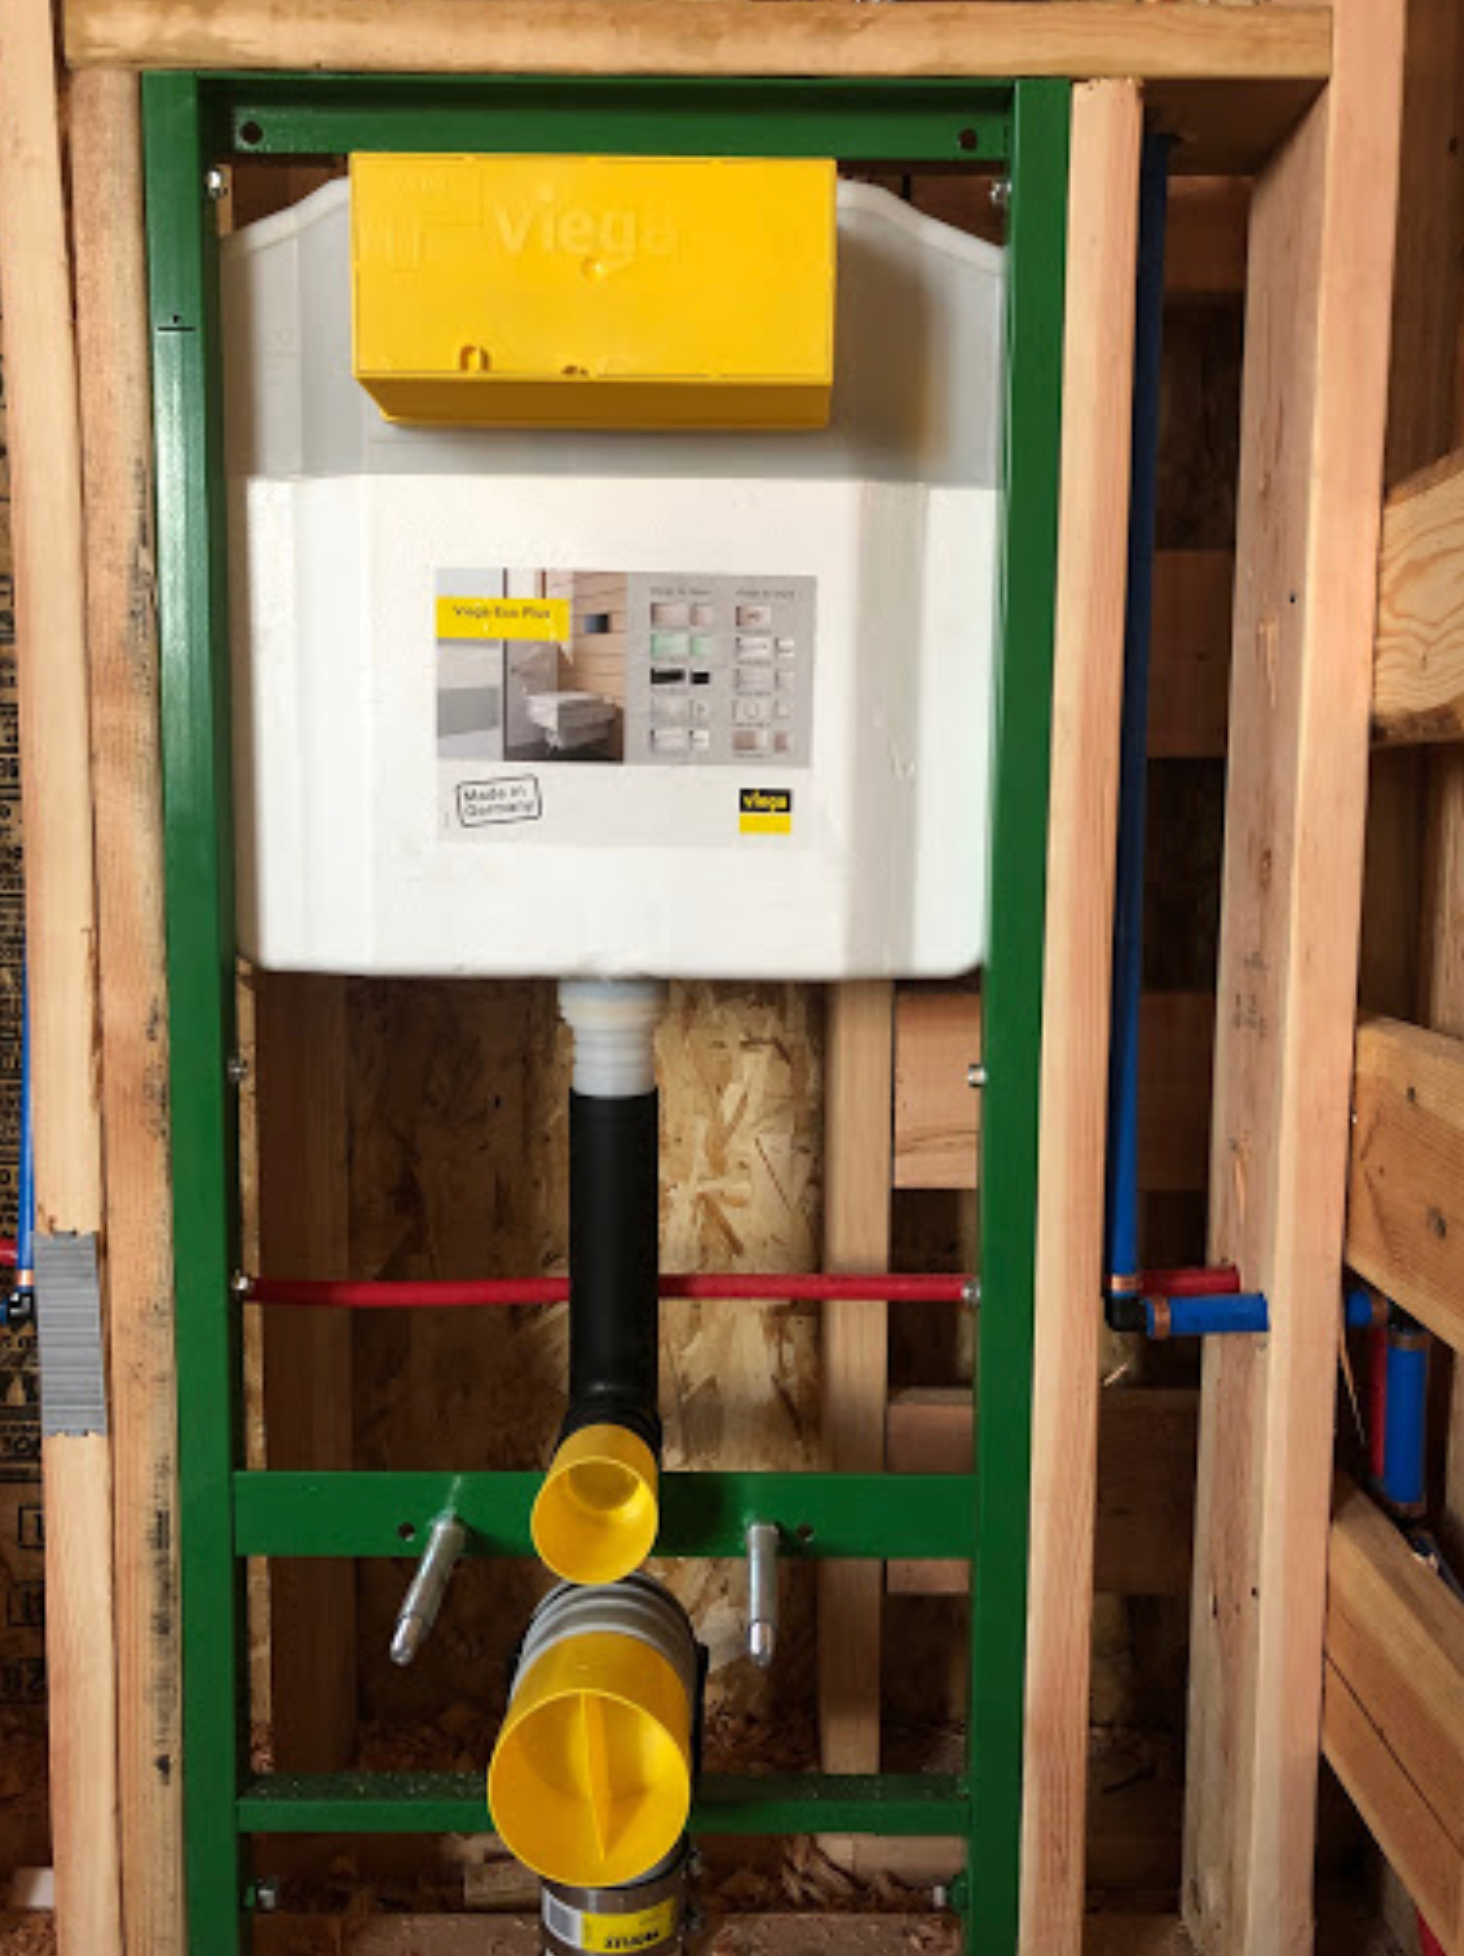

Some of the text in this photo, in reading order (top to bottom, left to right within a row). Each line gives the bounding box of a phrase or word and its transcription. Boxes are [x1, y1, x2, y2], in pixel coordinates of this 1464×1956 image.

[452, 604, 550, 620] Viega Eco Plus
[464, 784, 527, 801] Made in
[464, 800, 535, 817] Germany
